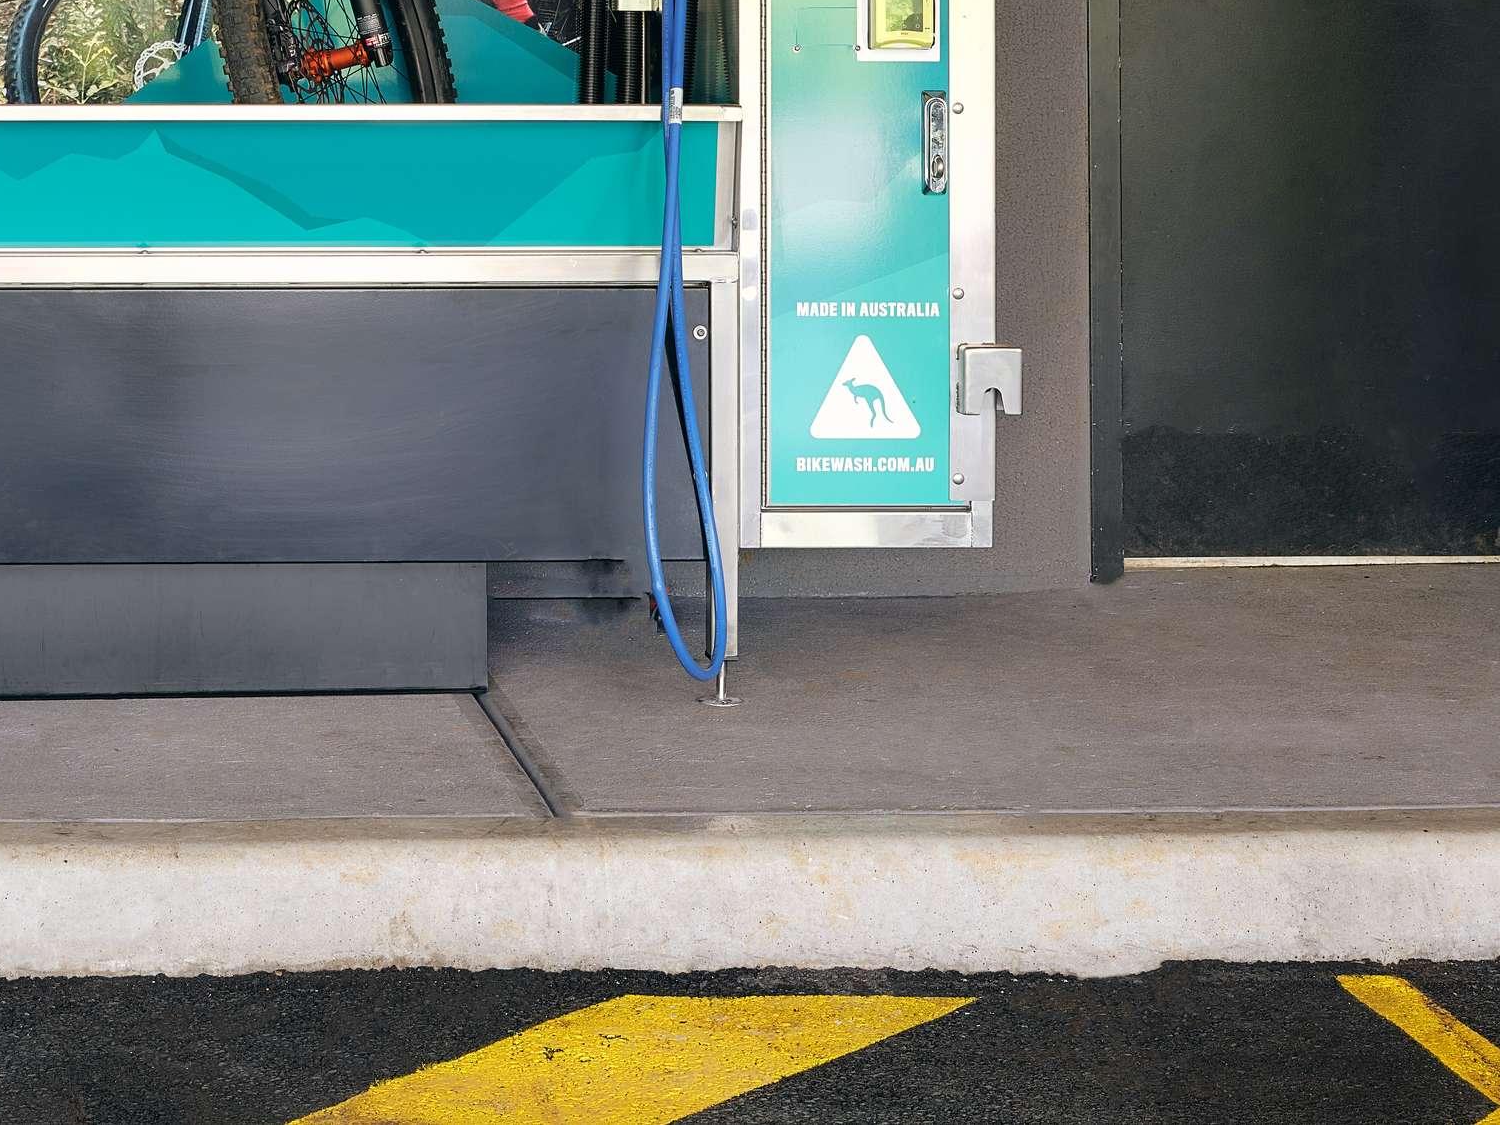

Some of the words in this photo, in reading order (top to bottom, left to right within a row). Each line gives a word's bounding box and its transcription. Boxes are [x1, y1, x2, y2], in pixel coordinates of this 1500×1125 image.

[796, 302, 837, 317] MADE
[841, 302, 856, 317] IN
[859, 302, 940, 317] AUSTRALIA
[796, 457, 935, 472] BIKEWASH.COM.AU
